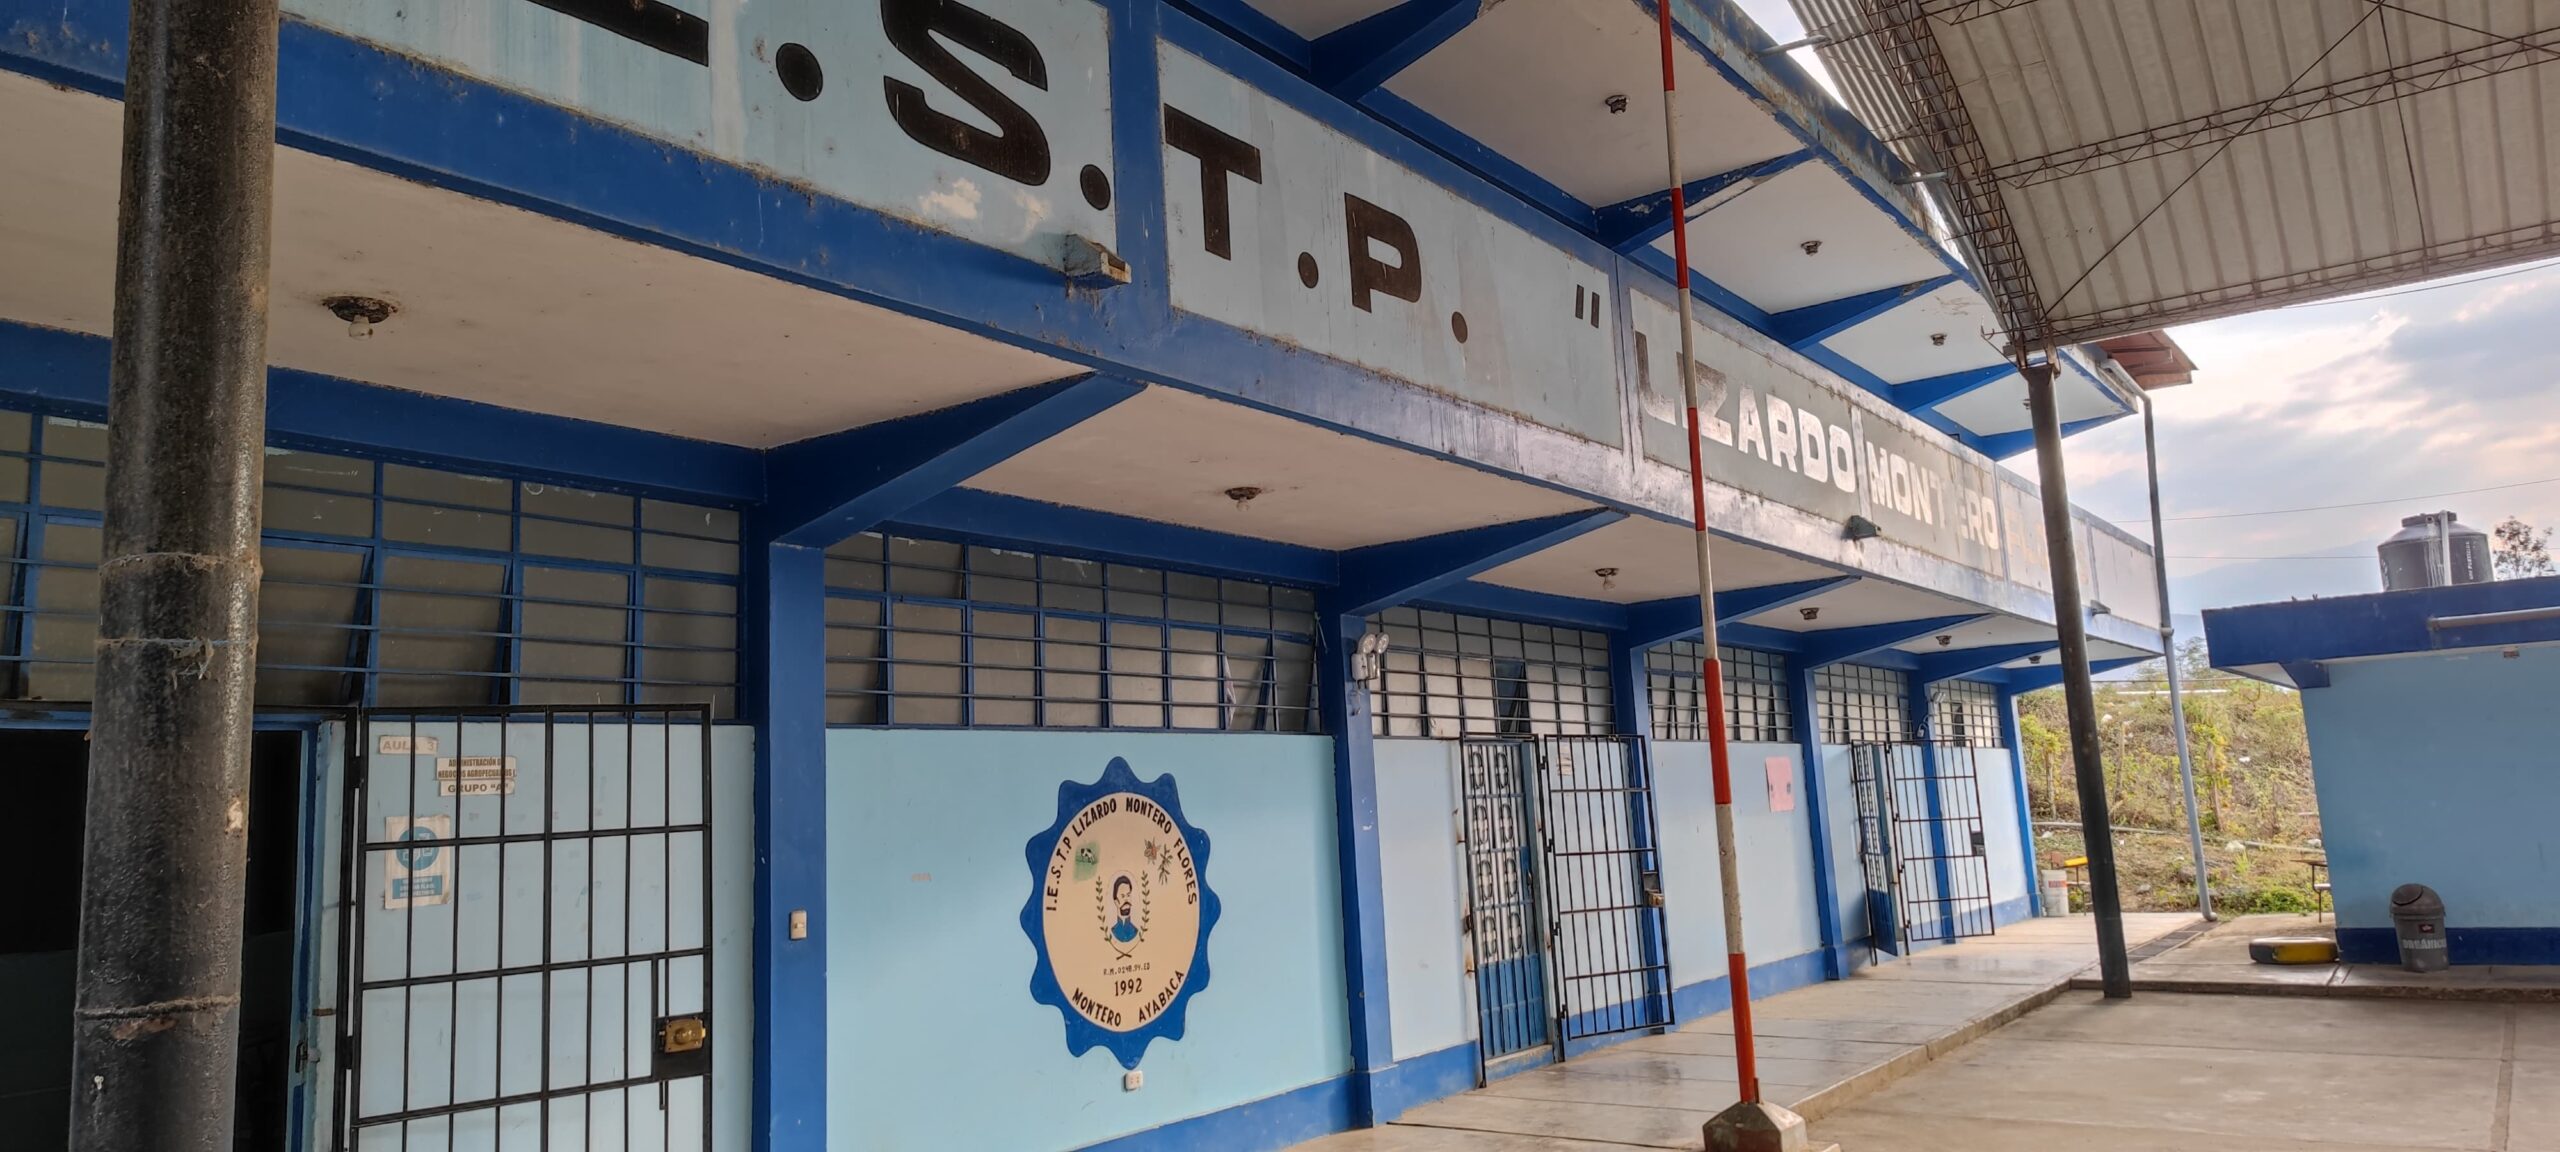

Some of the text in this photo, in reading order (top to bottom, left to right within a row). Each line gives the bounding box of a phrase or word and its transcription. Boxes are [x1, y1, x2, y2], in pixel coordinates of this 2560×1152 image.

[1866, 441, 2000, 550] MONTERO
[448, 757, 497, 767] ADINISTRACIÓN
[1072, 797, 1117, 837] LIZARDO
[1126, 797, 1172, 835] MONTERO
[1173, 837, 1197, 905] FLORES
[1072, 970, 1184, 1028] MONTERO AYABACA
[1115, 977, 1142, 997] 1992
